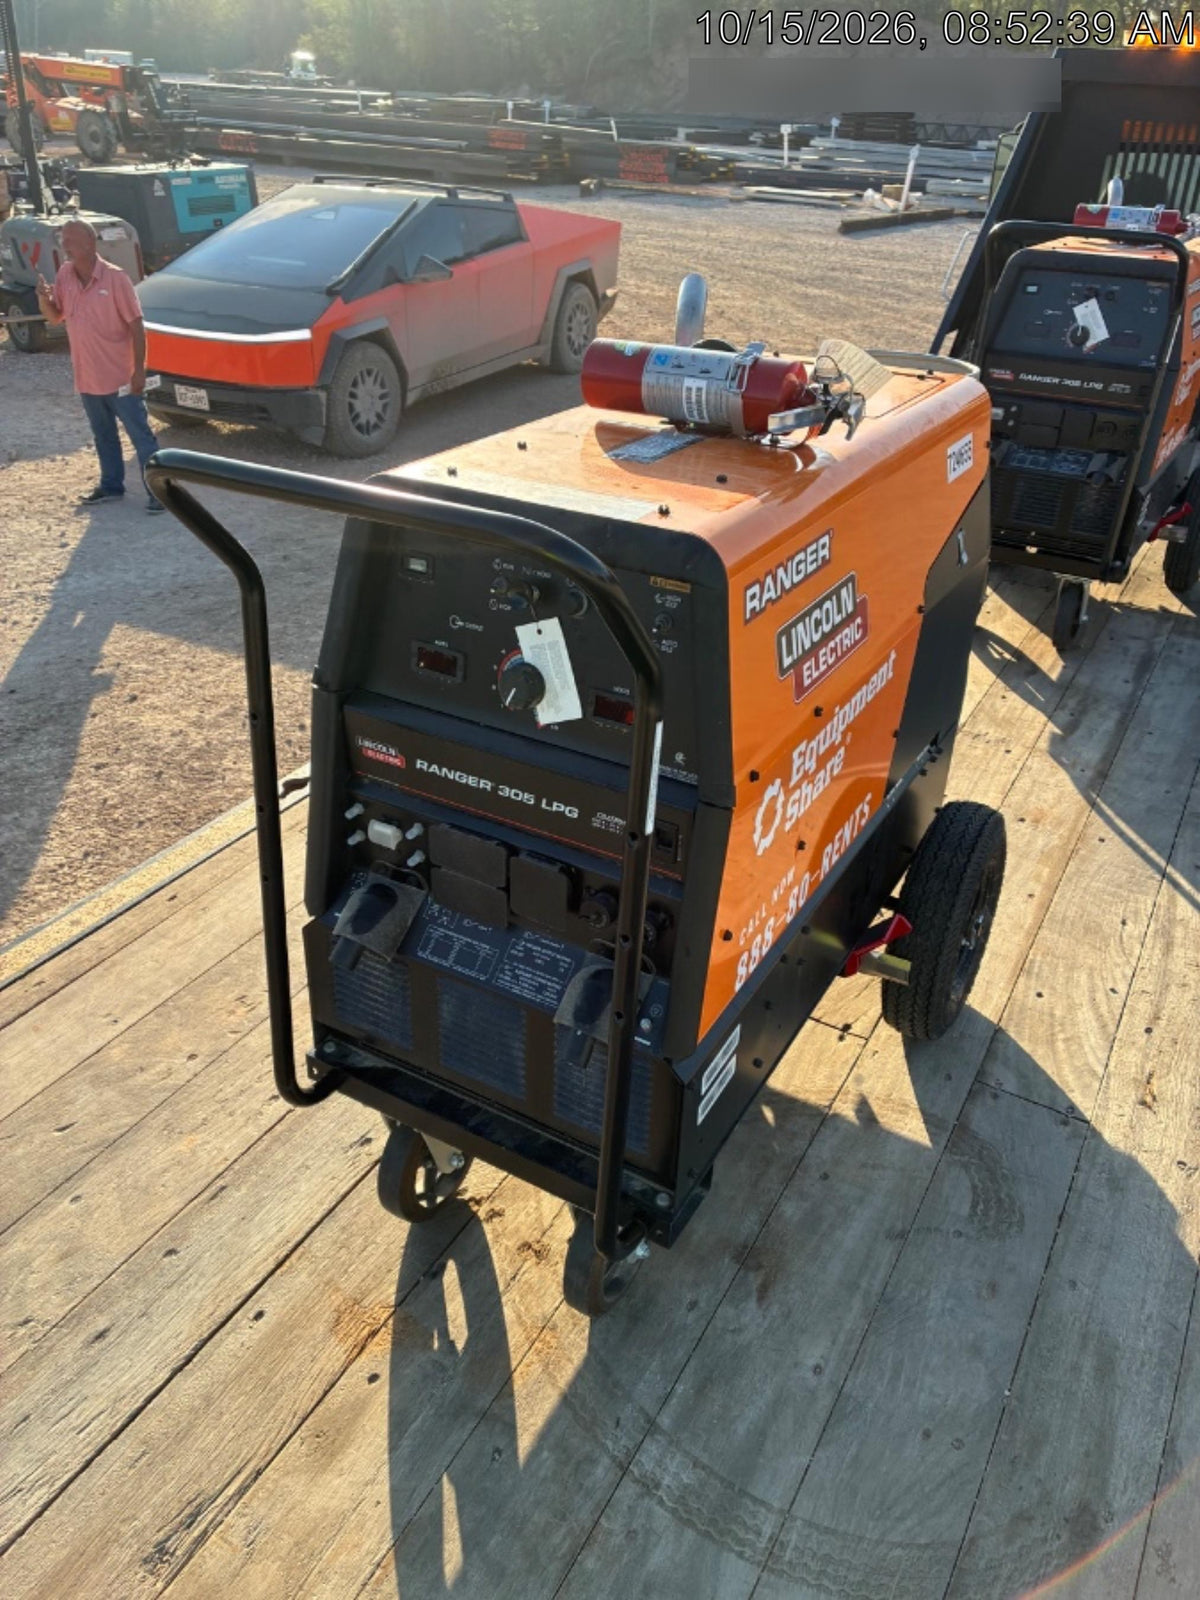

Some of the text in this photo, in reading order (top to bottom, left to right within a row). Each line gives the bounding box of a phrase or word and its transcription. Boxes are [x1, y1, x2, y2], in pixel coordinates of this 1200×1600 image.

[745, 533, 832, 620] RANGER
[781, 580, 856, 669] LINCOLN
[803, 617, 863, 688] ELECTRIC
[790, 649, 896, 787] Equipment
[415, 757, 579, 819] RANGER 305 LPG
[784, 745, 846, 832] Share
[734, 792, 872, 994] 888-80-RENTS
[739, 902, 767, 946] CALL
